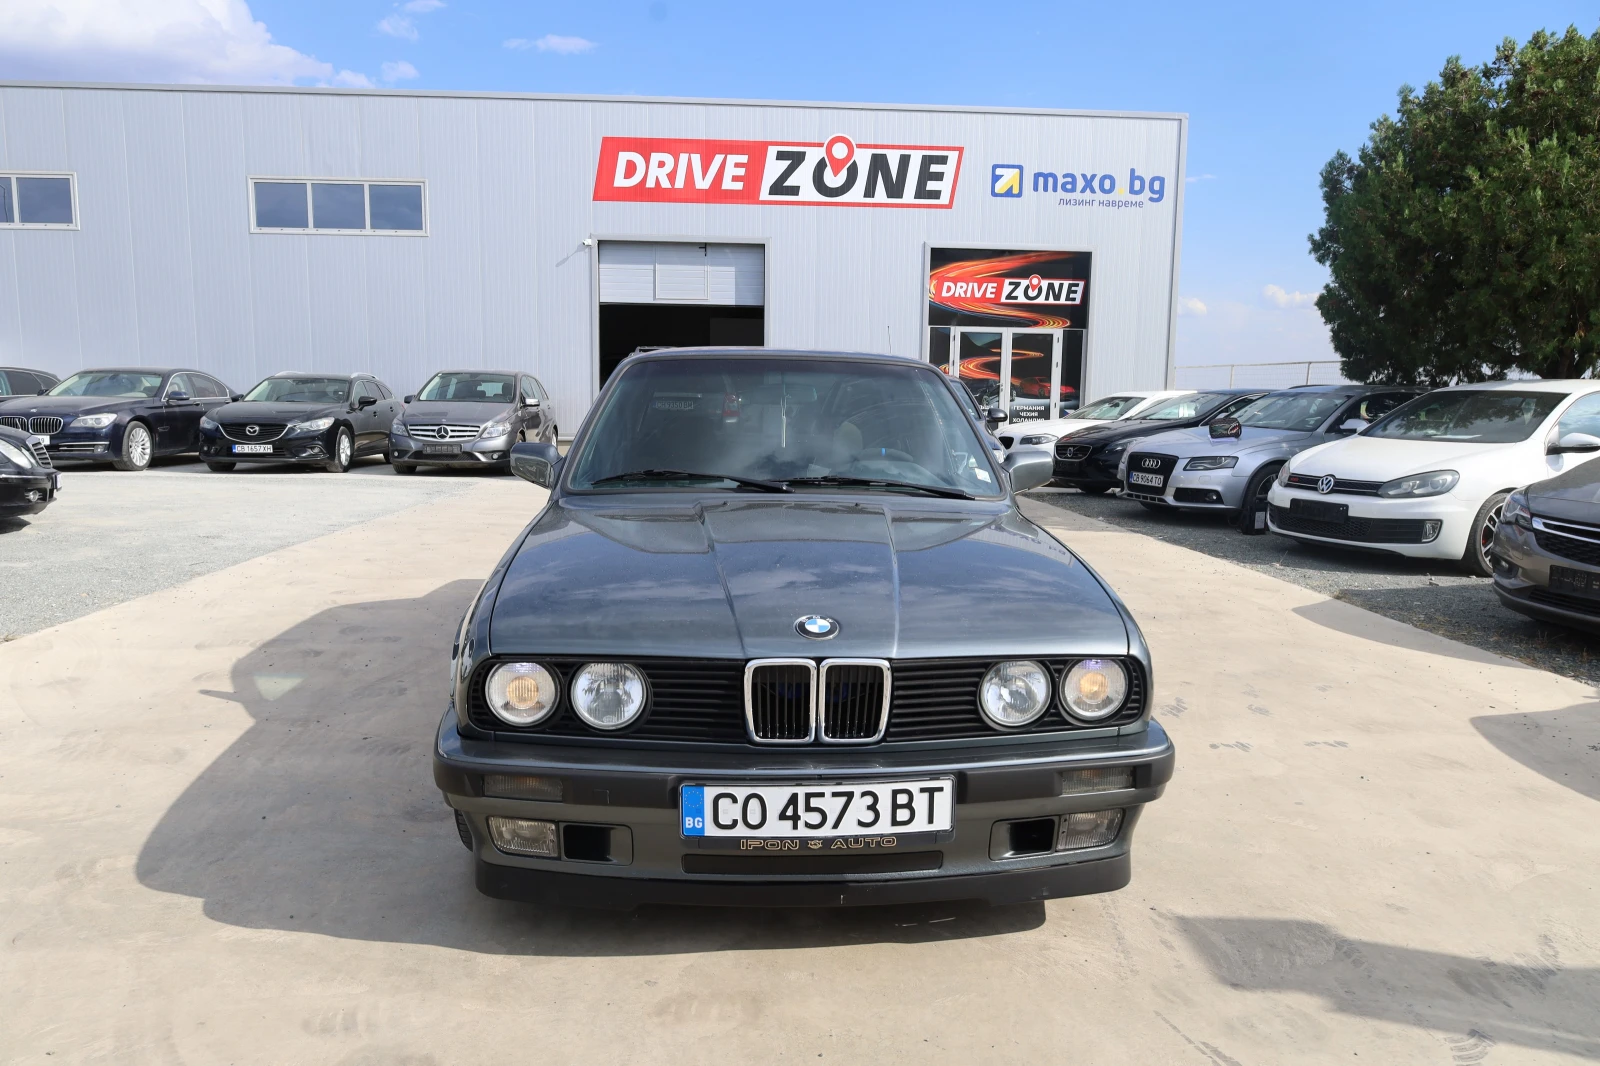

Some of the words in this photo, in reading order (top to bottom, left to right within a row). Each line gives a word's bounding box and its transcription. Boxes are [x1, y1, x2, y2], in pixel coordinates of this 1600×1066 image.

[613, 151, 749, 191] DRIVE
[768, 150, 948, 200] ZONE
[1033, 168, 1165, 203] maxo.bg
[1058, 198, 1096, 207] лизинг
[1098, 199, 1144, 209] навреме
[941, 281, 998, 299] DRIVE
[1005, 281, 1079, 302] ZONE
[685, 817, 703, 829] BG
[712, 792, 768, 830] CO
[778, 790, 881, 830] 4573
[890, 786, 944, 827] BT
[740, 839, 799, 850] IPON
[830, 836, 897, 849] AUTO
